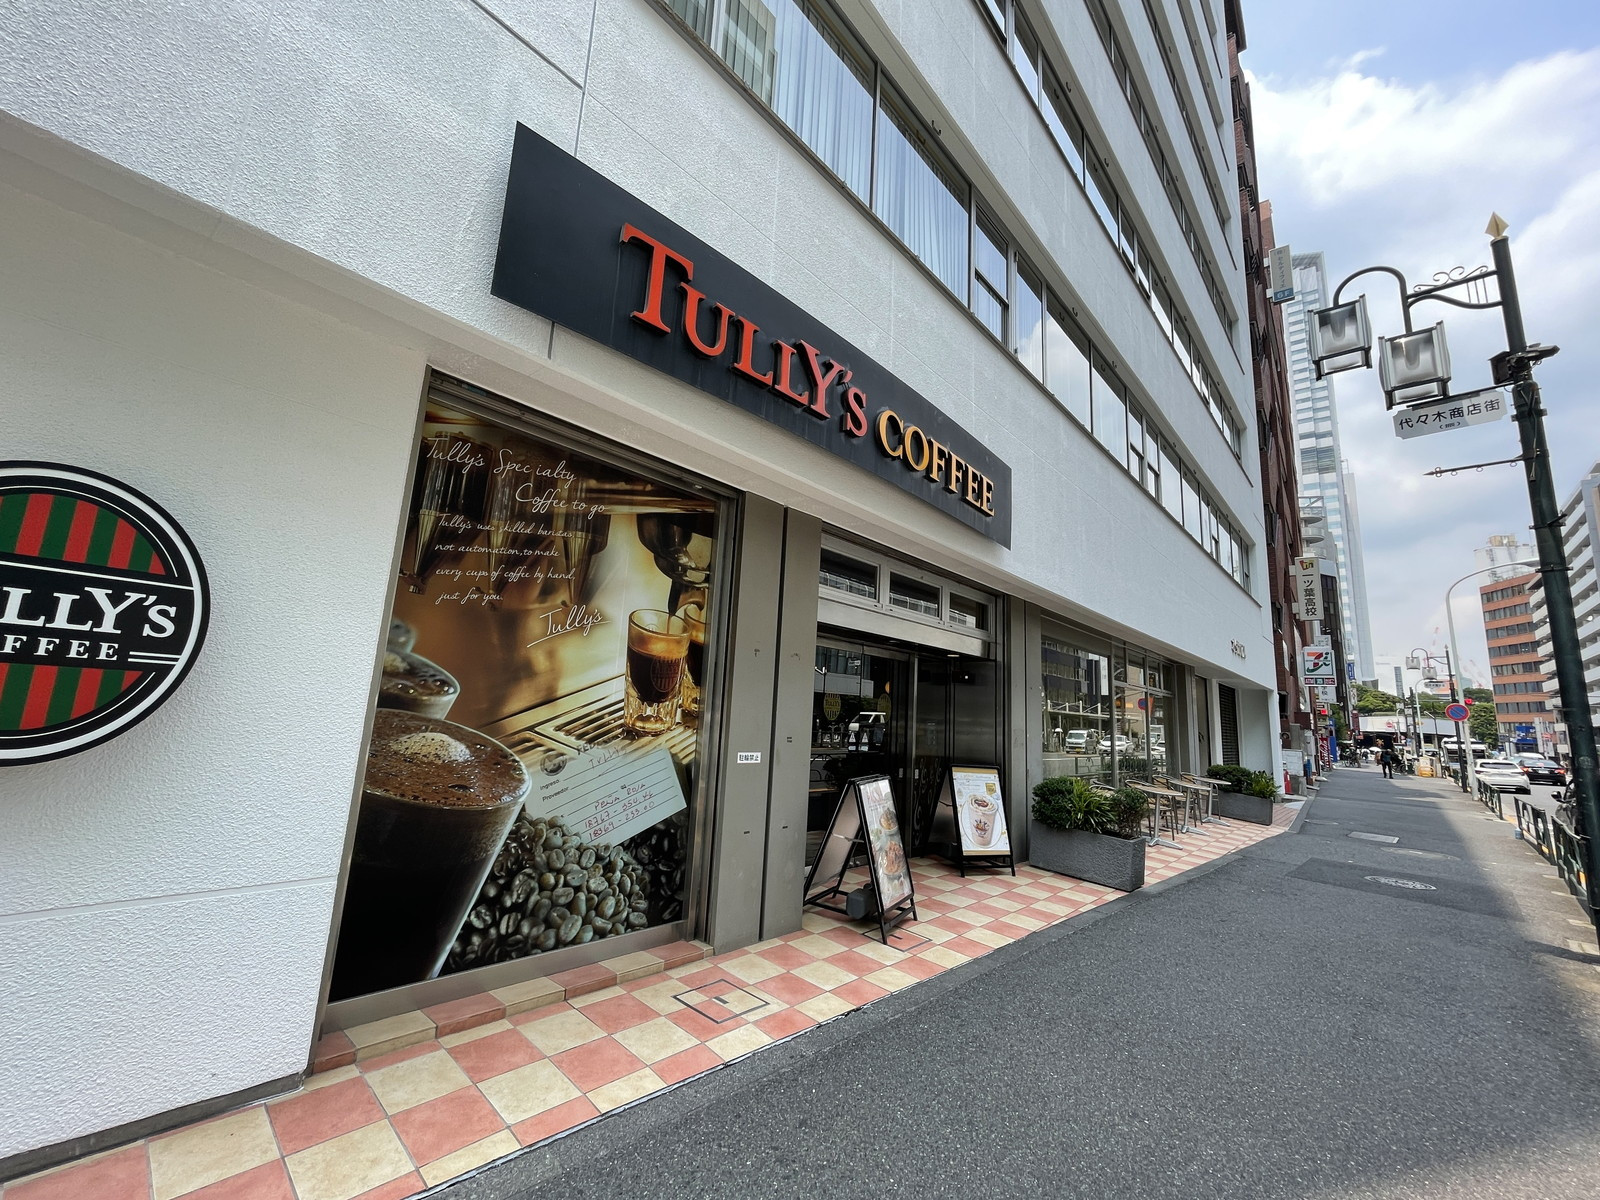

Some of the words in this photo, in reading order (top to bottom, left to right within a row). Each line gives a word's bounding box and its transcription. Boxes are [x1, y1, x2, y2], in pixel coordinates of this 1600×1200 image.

[619, 222, 868, 437] TULLY'S
[875, 409, 996, 518] COFFEE
[1398, 398, 1500, 432] 代々木商店街
[426, 437, 486, 473] Tully's
[493, 448, 577, 489] Specialty
[515, 482, 567, 514] Coffee
[572, 499, 588, 512] to
[590, 503, 609, 520] go
[437, 513, 473, 534] Tully's
[499, 520, 534, 535] skilled
[434, 543, 455, 552] not
[534, 545, 561, 558] make
[435, 567, 463, 582] every
[465, 568, 489, 582] cups
[490, 564, 505, 583] of
[504, 566, 531, 582] coffee
[533, 566, 546, 584] by
[547, 567, 576, 580] hand,
[434, 590, 461, 605] just
[460, 586, 481, 606] for
[1301, 573, 1317, 617] 一ツ葉高校
[0, 586, 177, 638] LLY'S
[539, 604, 604, 637] Tully's
[0, 634, 119, 662] FFEE
